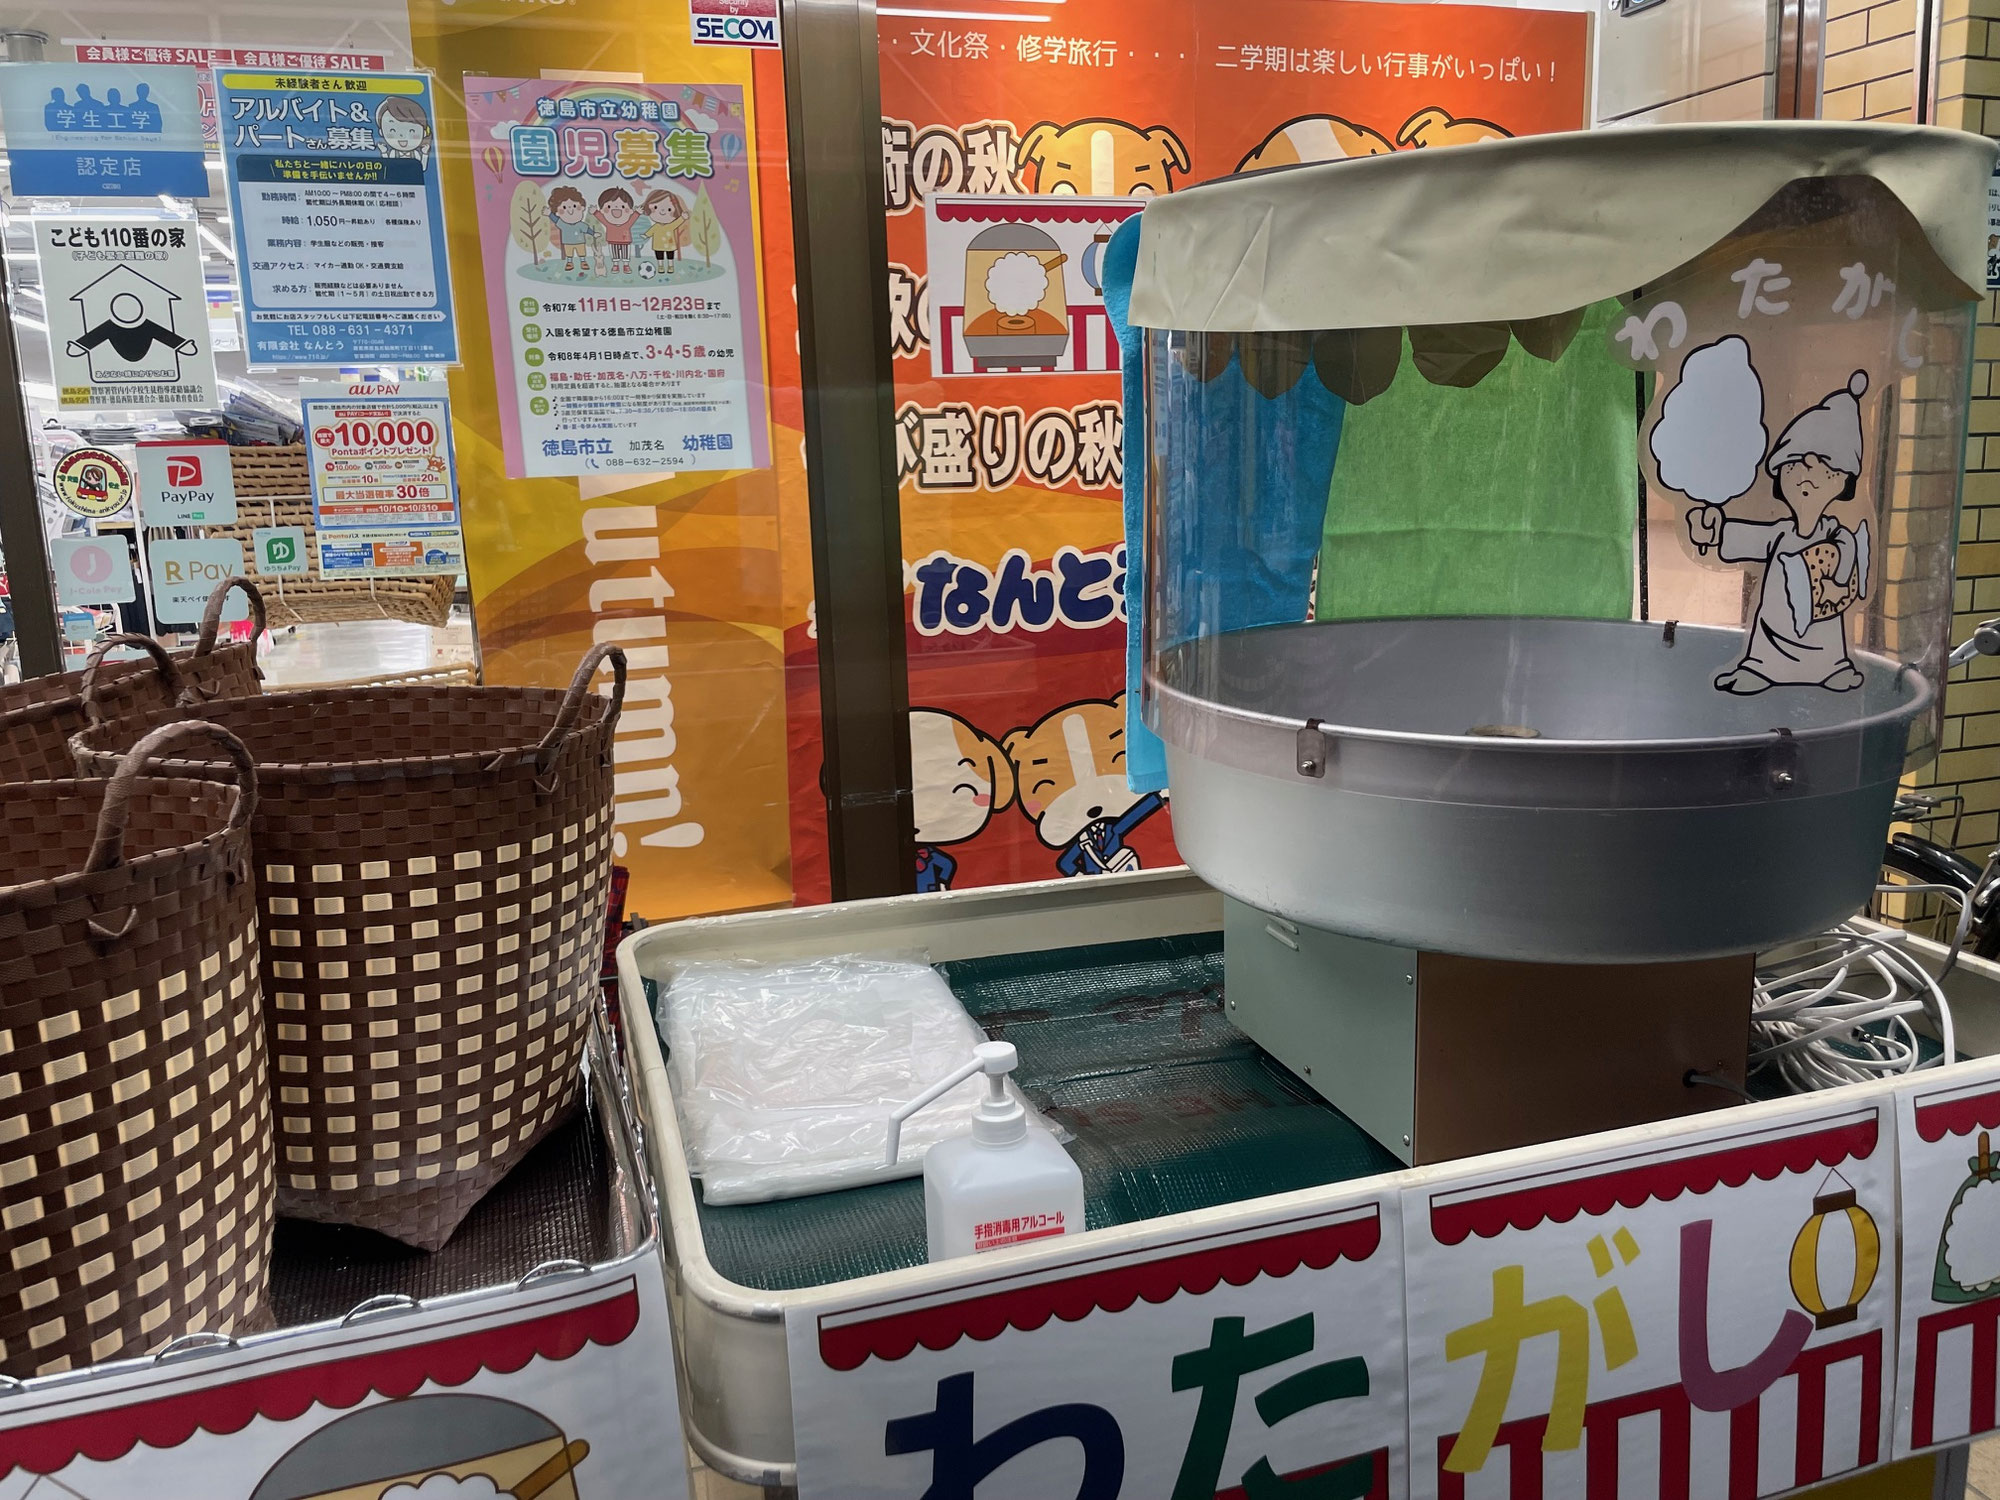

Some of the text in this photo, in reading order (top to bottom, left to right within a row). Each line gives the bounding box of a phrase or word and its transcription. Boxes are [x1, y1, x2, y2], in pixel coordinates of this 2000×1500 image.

[730, 6, 738, 14] by
[697, 18, 774, 40] SECOM
[86, 46, 216, 63] 会員様ご優待 SALE
[244, 52, 370, 70] 会員様ご優待 SALE
[1215, 44, 1555, 82] 二学期は楽しい行事がいっぱい！
[537, 98, 679, 120] 徳島市立幼稚園
[56, 110, 150, 129] 学生工学
[510, 125, 715, 180] 園児募集
[76, 156, 142, 176] 認定店
[51, 227, 186, 248] こども110番の家
[1615, 258, 1924, 368] わたがし
[288, 324, 308, 336] TEL
[545, 326, 672, 338] 入園を希望する徳島市立幼稚園
[256, 340, 300, 351] 有限会社
[304, 340, 344, 350] なんとう
[348, 384, 400, 396] au PAY
[335, 422, 434, 447] 10,000
[542, 434, 733, 456] 徳島市立 加茂名 幼稚園
[161, 490, 214, 504] PayPay
[165, 561, 184, 581] R
[974, 1210, 1065, 1240] 手指消毒用アルコール
